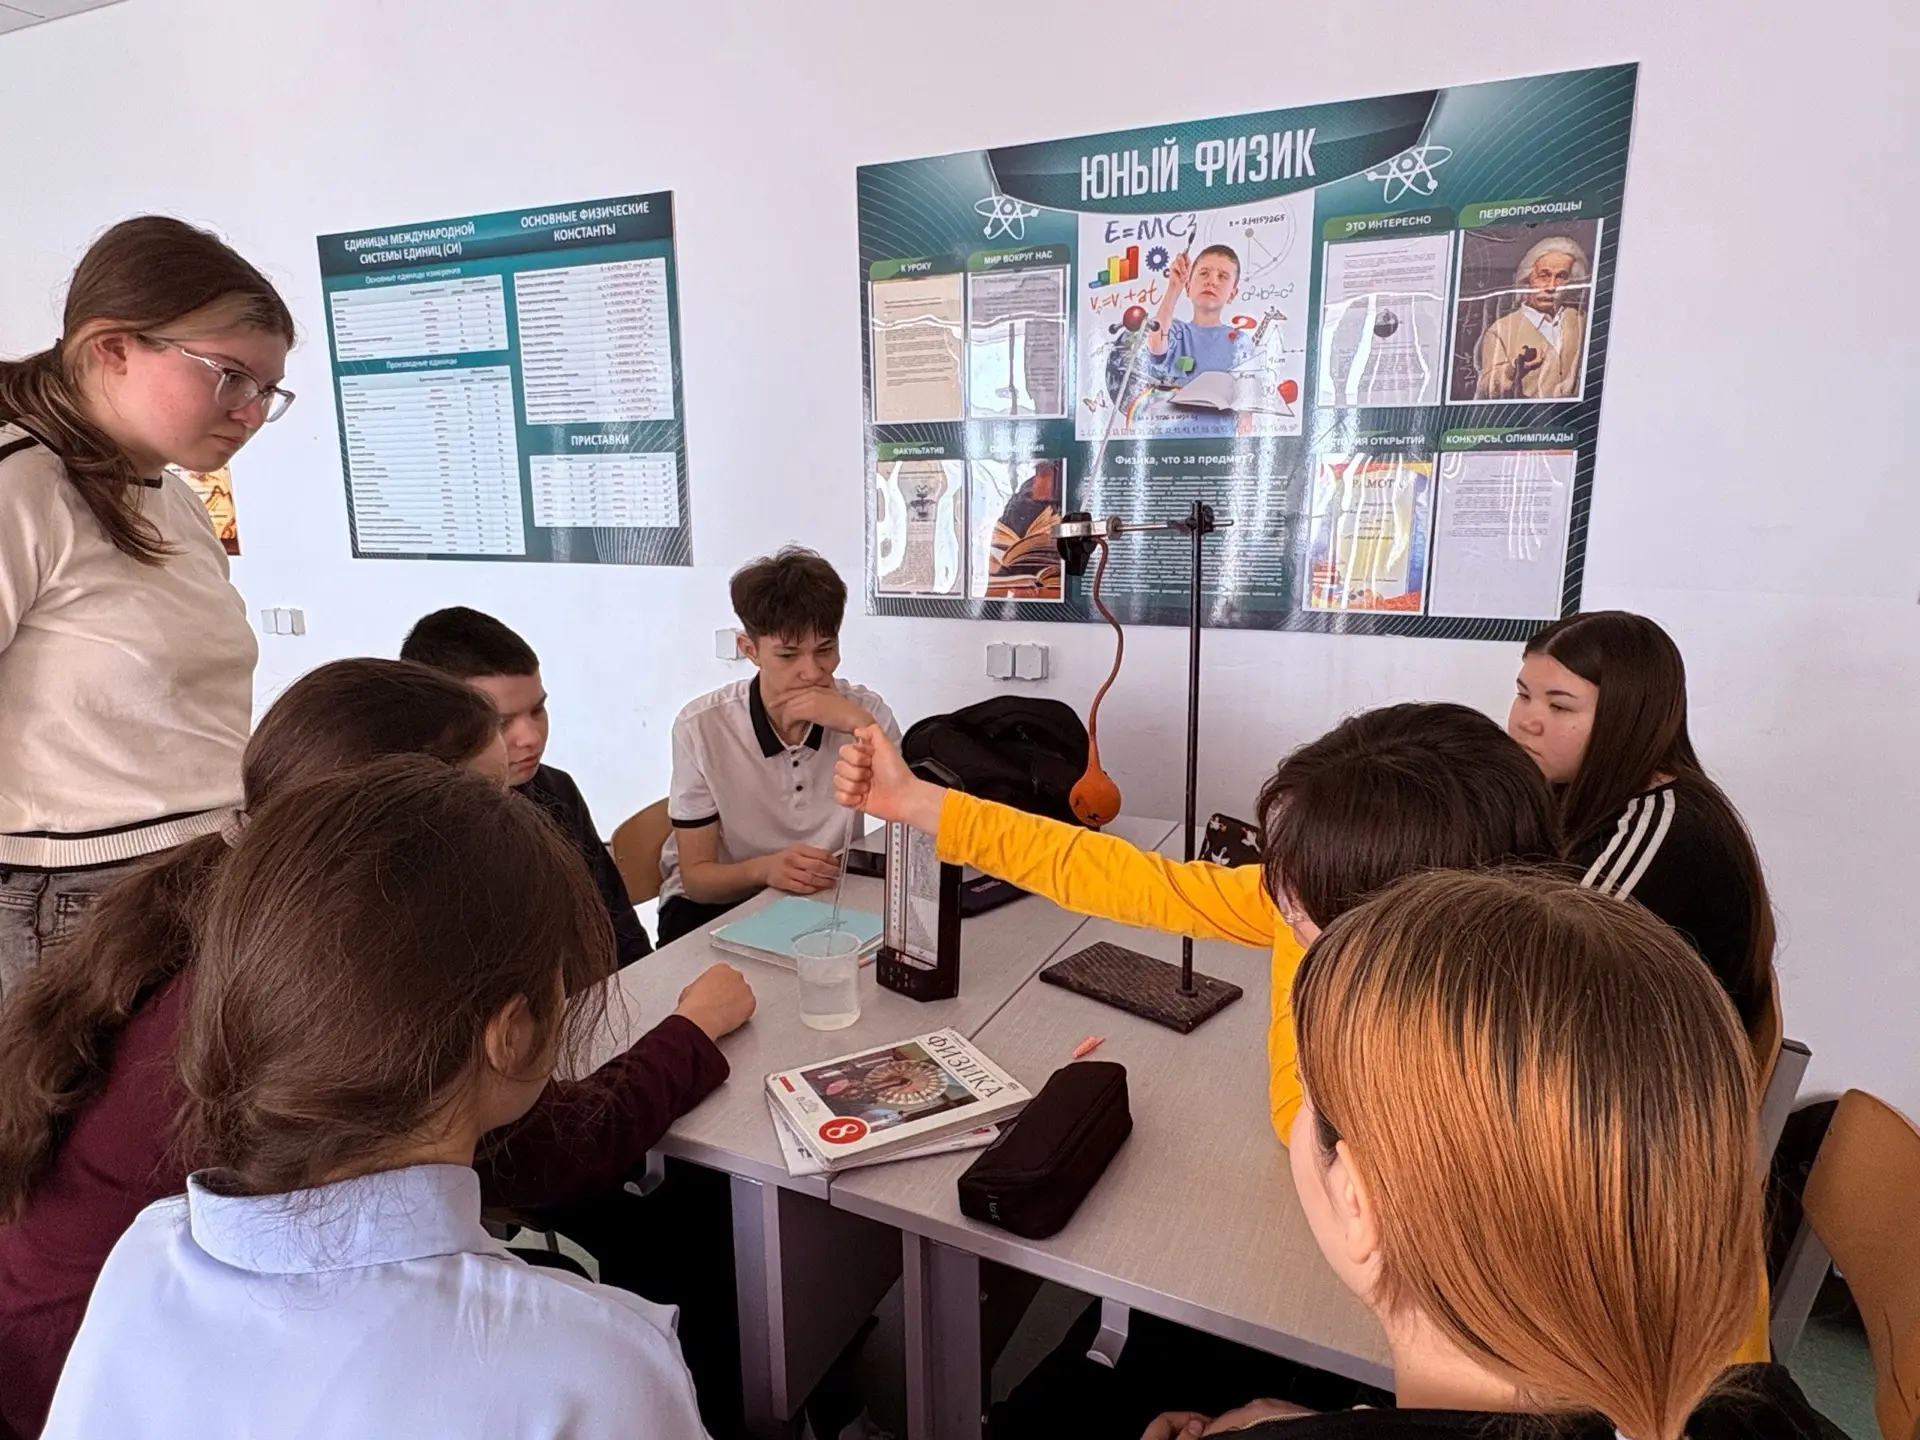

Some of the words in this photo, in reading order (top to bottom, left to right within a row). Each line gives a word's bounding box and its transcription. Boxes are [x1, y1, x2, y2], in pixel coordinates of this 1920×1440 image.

[1080, 137, 1179, 201] ЮНЫЙ
[1195, 127, 1317, 188] ФИЗИК
[520, 210, 577, 228] ОСНОВНЫЕ
[579, 201, 650, 221] ФИЗИЧЕСКИЕ
[1478, 201, 1583, 220] ПЕРВОПРОХОДЦЫ
[1345, 221, 1366, 232] ЭТО
[1368, 215, 1432, 230] ИНТЕРЕСНО
[344, 235, 389, 252] ЕДИНИЦЫ
[389, 221, 475, 245] МЕЖДУНАРОДНОЙ
[553, 223, 616, 242] КОНСТАНТЫ
[359, 250, 402, 265] СИСТЕМЫ
[403, 245, 442, 261] ЕДИНИЦ
[442, 241, 463, 257] (СИ)
[983, 256, 1001, 266] МИР
[1002, 254, 1033, 264] ВОКРУГ
[1035, 251, 1053, 261] НАС
[901, 264, 906, 272] К
[907, 262, 932, 273] УРОКУ
[570, 435, 630, 447] ПРИСТАВКИ
[1370, 436, 1426, 446] ОТКРЫТИЙ
[1446, 434, 1503, 445] КОНКУРСЫ,
[1505, 432, 1574, 444] ОЛИМПИАДЫ
[893, 446, 945, 455] ФАКУЛЬТАТИВ
[1115, 454, 1159, 466] Физика,
[1161, 456, 1180, 465] что
[1183, 456, 1195, 465] за
[927, 1035, 1005, 1098] ФИЗИКА
[826, 1123, 859, 1139] 8
